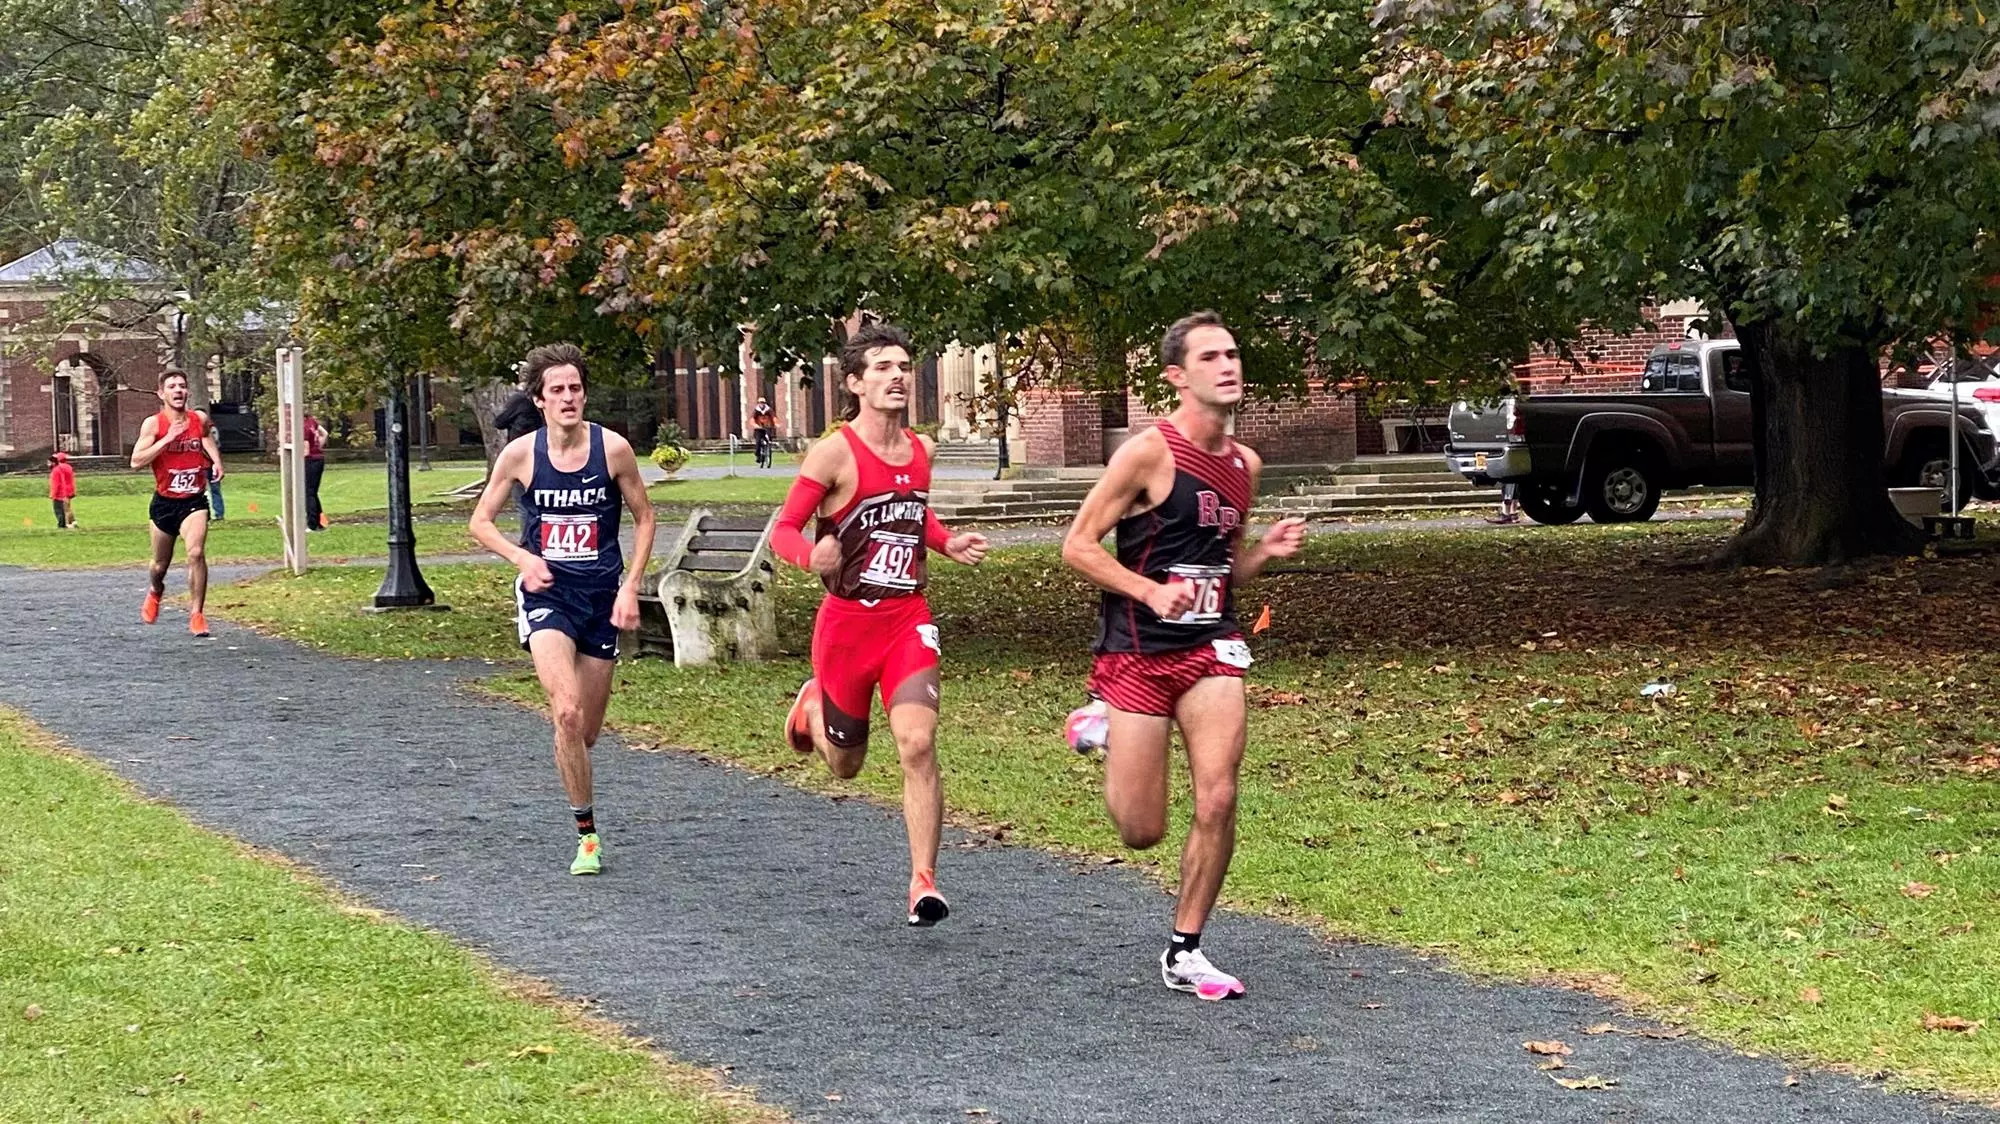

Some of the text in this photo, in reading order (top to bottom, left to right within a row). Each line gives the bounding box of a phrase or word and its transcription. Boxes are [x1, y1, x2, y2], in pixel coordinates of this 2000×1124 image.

[171, 473, 196, 489] 452
[534, 487, 607, 507] ITHACA
[859, 507, 880, 530] ST.
[547, 524, 592, 553] 442
[869, 543, 914, 580] 492
[1186, 577, 1221, 614] 76
